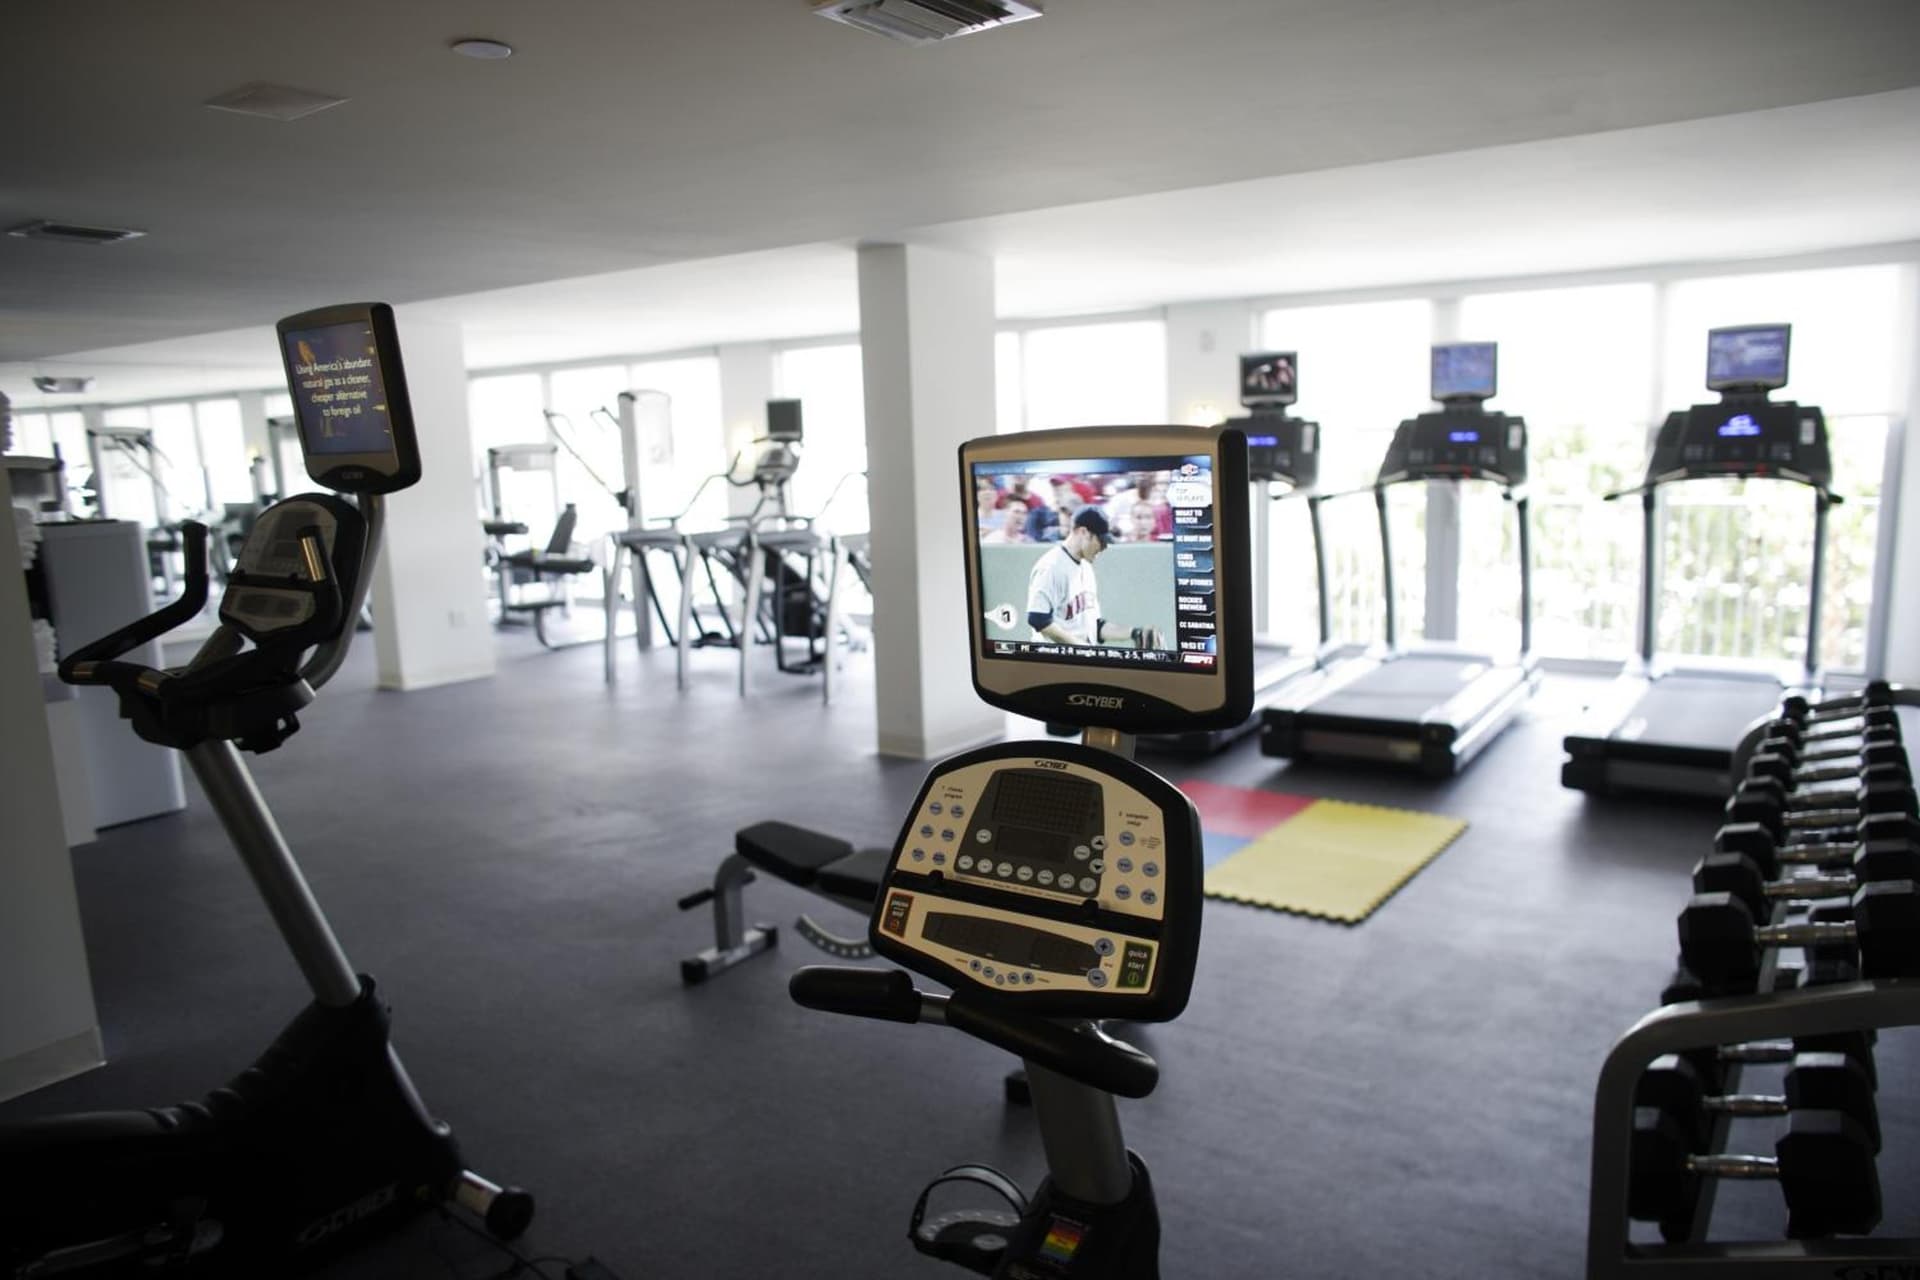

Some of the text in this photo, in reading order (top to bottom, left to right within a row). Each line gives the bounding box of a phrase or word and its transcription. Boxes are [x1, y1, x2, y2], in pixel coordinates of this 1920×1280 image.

[1085, 695, 1124, 710] CYBEX
[1127, 949, 1149, 960] quick
[1127, 960, 1145, 972] start
